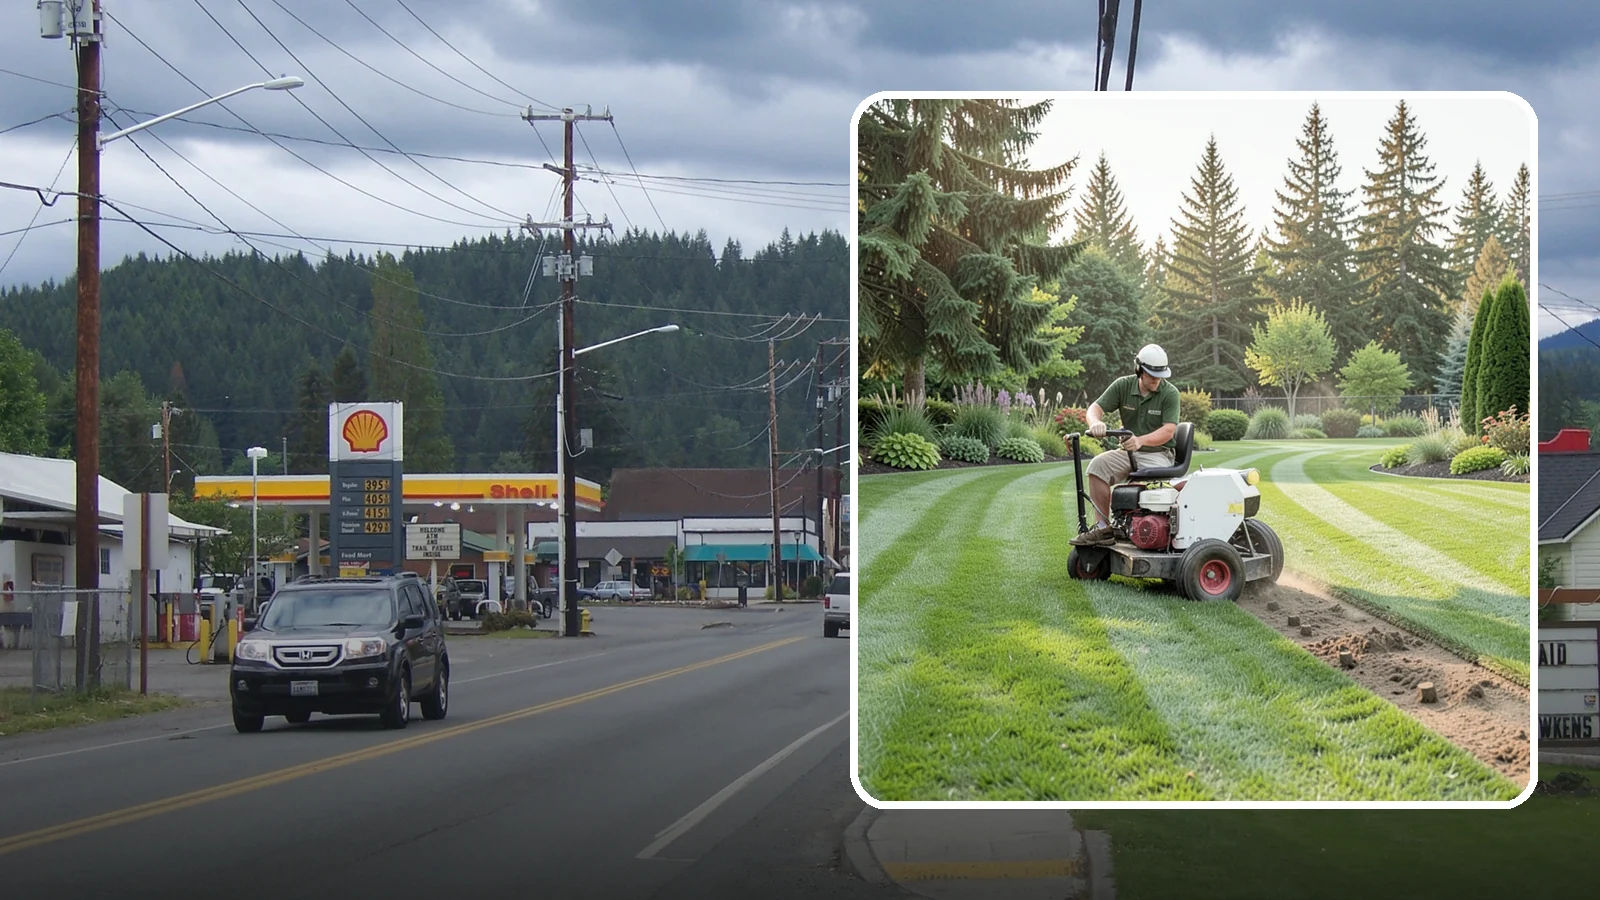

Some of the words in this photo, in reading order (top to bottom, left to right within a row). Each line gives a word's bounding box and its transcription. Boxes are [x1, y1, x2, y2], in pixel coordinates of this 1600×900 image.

[366, 480, 384, 490] 395
[490, 485, 547, 499] Shell
[366, 494, 384, 504] 405
[366, 508, 384, 518] 415
[366, 522, 384, 532] 429
[1538, 643, 1566, 665] AID
